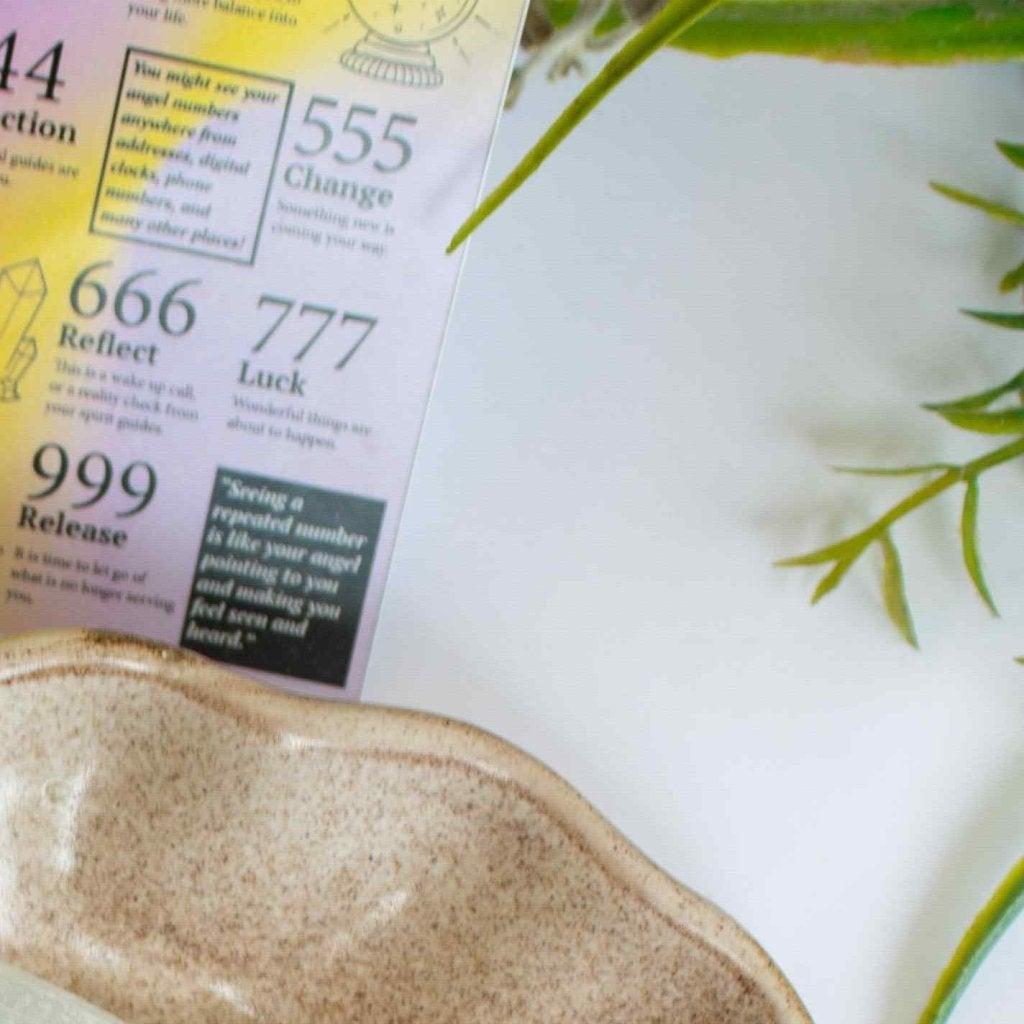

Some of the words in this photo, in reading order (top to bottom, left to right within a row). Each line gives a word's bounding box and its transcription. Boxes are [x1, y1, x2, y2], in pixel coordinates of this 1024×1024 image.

[128, 3, 160, 20] your
[269, 9, 297, 27] into
[134, 60, 161, 80] You
[165, 71, 211, 90] might
[215, 82, 239, 96] see
[242, 88, 279, 104] your
[126, 89, 170, 107] angel
[172, 99, 240, 123] numbers
[120, 113, 196, 139] anywhere
[197, 126, 237, 147] from
[294, 95, 418, 174] 555
[9, 155, 55, 174] guides
[58, 164, 79, 179] are
[163, 171, 213, 194] phone
[198, 152, 251, 176] digital
[283, 163, 393, 210] Change
[99, 210, 143, 233] many
[146, 219, 188, 239] other
[180, 203, 212, 219] and
[276, 197, 349, 230] Something
[353, 218, 380, 233] new
[384, 222, 395, 236] is
[271, 221, 322, 246] coming
[326, 234, 356, 251] your
[69, 261, 200, 337] 666
[58, 323, 158, 366] Reflect
[251, 294, 378, 371] 777
[56, 357, 82, 376] This
[111, 372, 145, 389] wake
[148, 381, 166, 399] up
[238, 360, 306, 397] Luck
[44, 401, 76, 418] your
[78, 409, 114, 425] spirit
[77, 387, 121, 407] reality
[123, 394, 161, 414] check
[164, 402, 199, 422] from
[232, 394, 305, 422] Wonderful
[307, 412, 350, 435] things
[226, 415, 265, 435] about
[268, 426, 282, 439] to
[28, 443, 157, 518] 999
[290, 497, 304, 512] a
[17, 504, 128, 548] Release
[211, 504, 294, 535] repeated
[295, 522, 368, 549] number
[42, 553, 74, 569] time
[75, 560, 91, 573] to
[92, 561, 110, 577] let
[111, 570, 129, 583] go
[131, 571, 148, 584] of
[206, 526, 223, 545] is
[226, 525, 261, 553] like
[263, 541, 308, 562] your
[309, 551, 362, 574] angel
[10, 568, 43, 584] what
[45, 575, 58, 588] is
[60, 580, 78, 592] no
[80, 580, 123, 603] longer
[125, 591, 176, 616] serving
[199, 553, 279, 589] pointing
[282, 568, 302, 586] to
[304, 575, 339, 595] you
[189, 597, 226, 621] feel
[227, 609, 268, 629] seen
[271, 614, 310, 638] and
[196, 577, 235, 597] and
[235, 584, 304, 616] making
[305, 601, 341, 620] you
